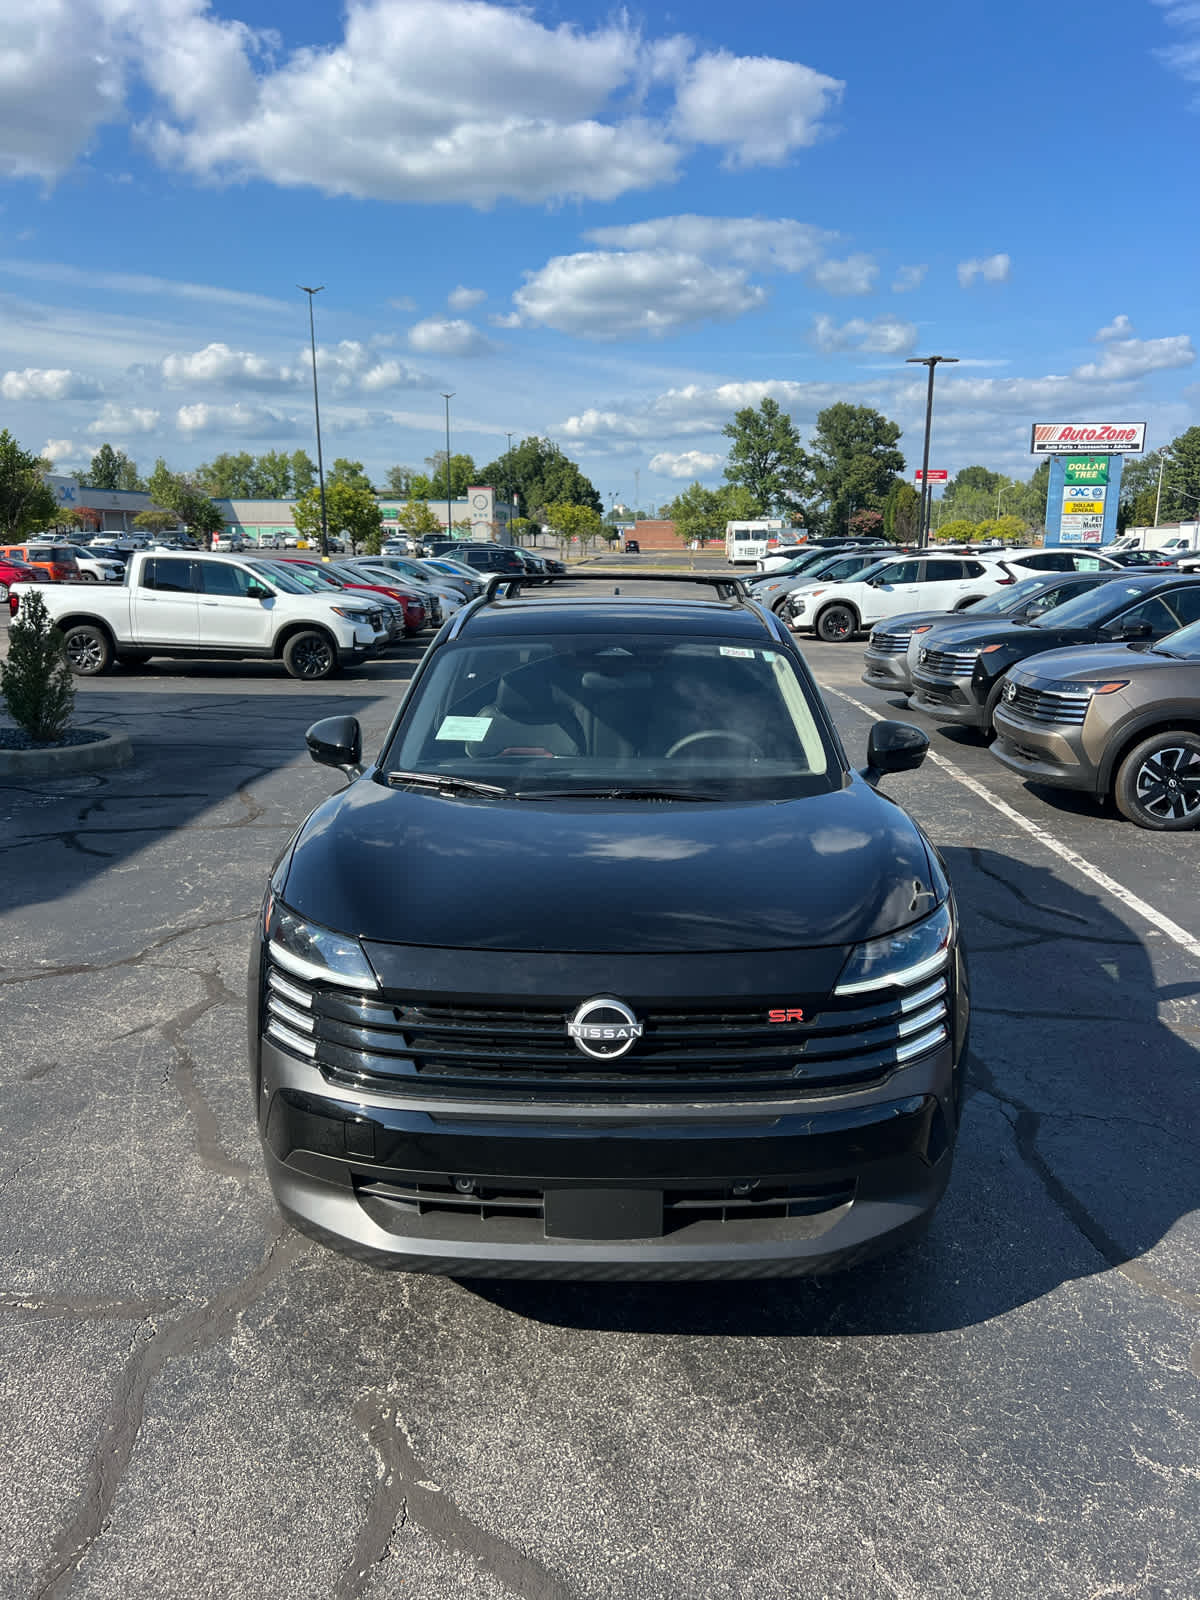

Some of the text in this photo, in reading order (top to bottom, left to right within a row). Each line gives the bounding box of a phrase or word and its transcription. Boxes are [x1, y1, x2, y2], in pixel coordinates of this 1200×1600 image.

[1058, 426, 1136, 442] AutoZone
[1068, 463, 1106, 471] DOLLAR
[1075, 471, 1098, 479] TREE
[768, 1008, 804, 1022] SR
[568, 1026, 642, 1039] NISSAN
